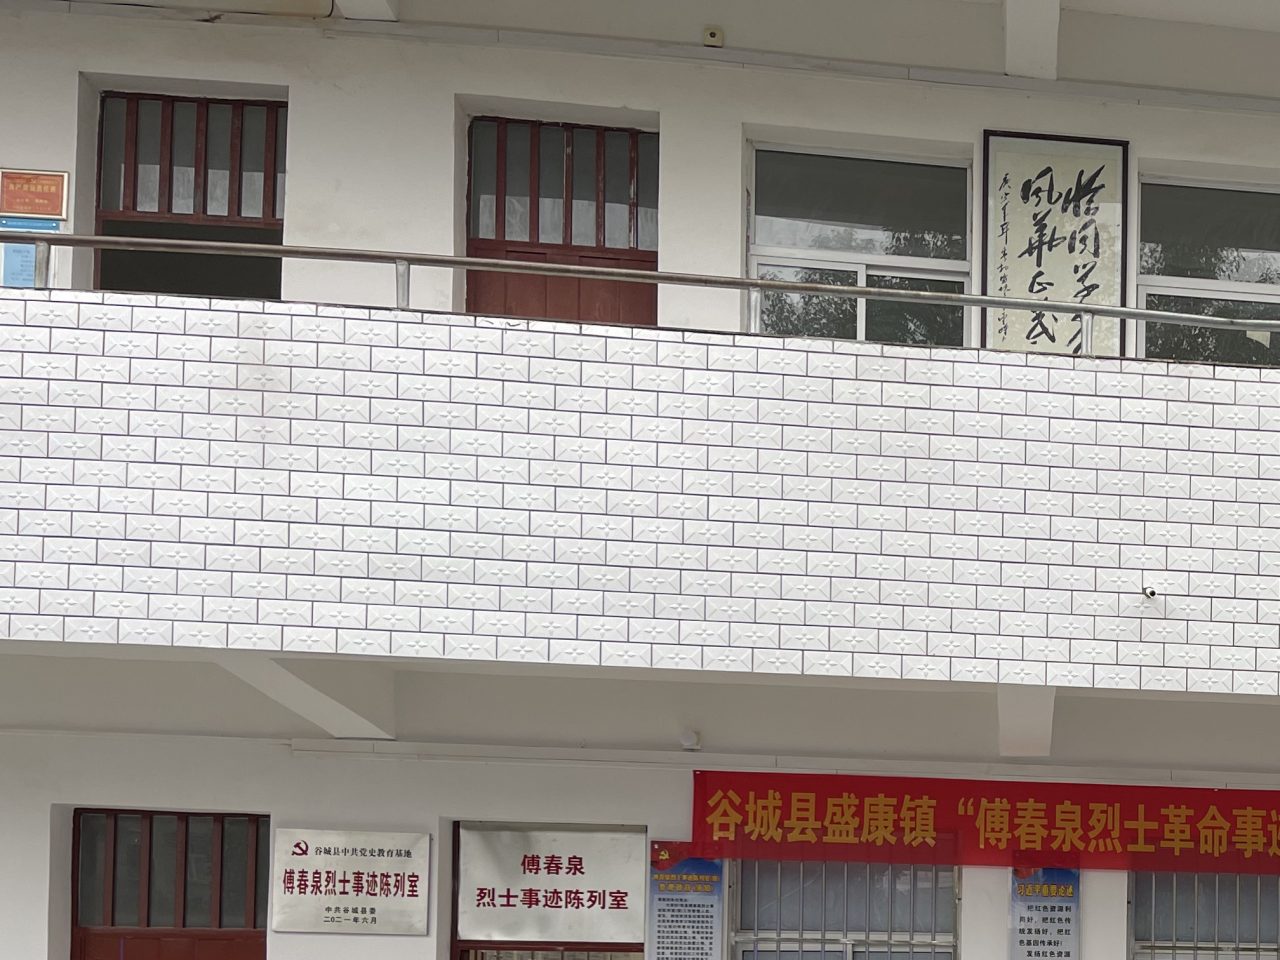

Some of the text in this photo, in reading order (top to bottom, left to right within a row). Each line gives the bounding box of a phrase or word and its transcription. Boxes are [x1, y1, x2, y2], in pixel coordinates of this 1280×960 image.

[314, 845, 413, 859] 谷城县中共党史教育基地
[521, 853, 586, 876] 傅春泉
[282, 868, 420, 898] 傅春泉烈士事迹陈列室
[1017, 883, 1073, 897] 习近平重要论述
[476, 887, 630, 911] 烈士事迹陈列室
